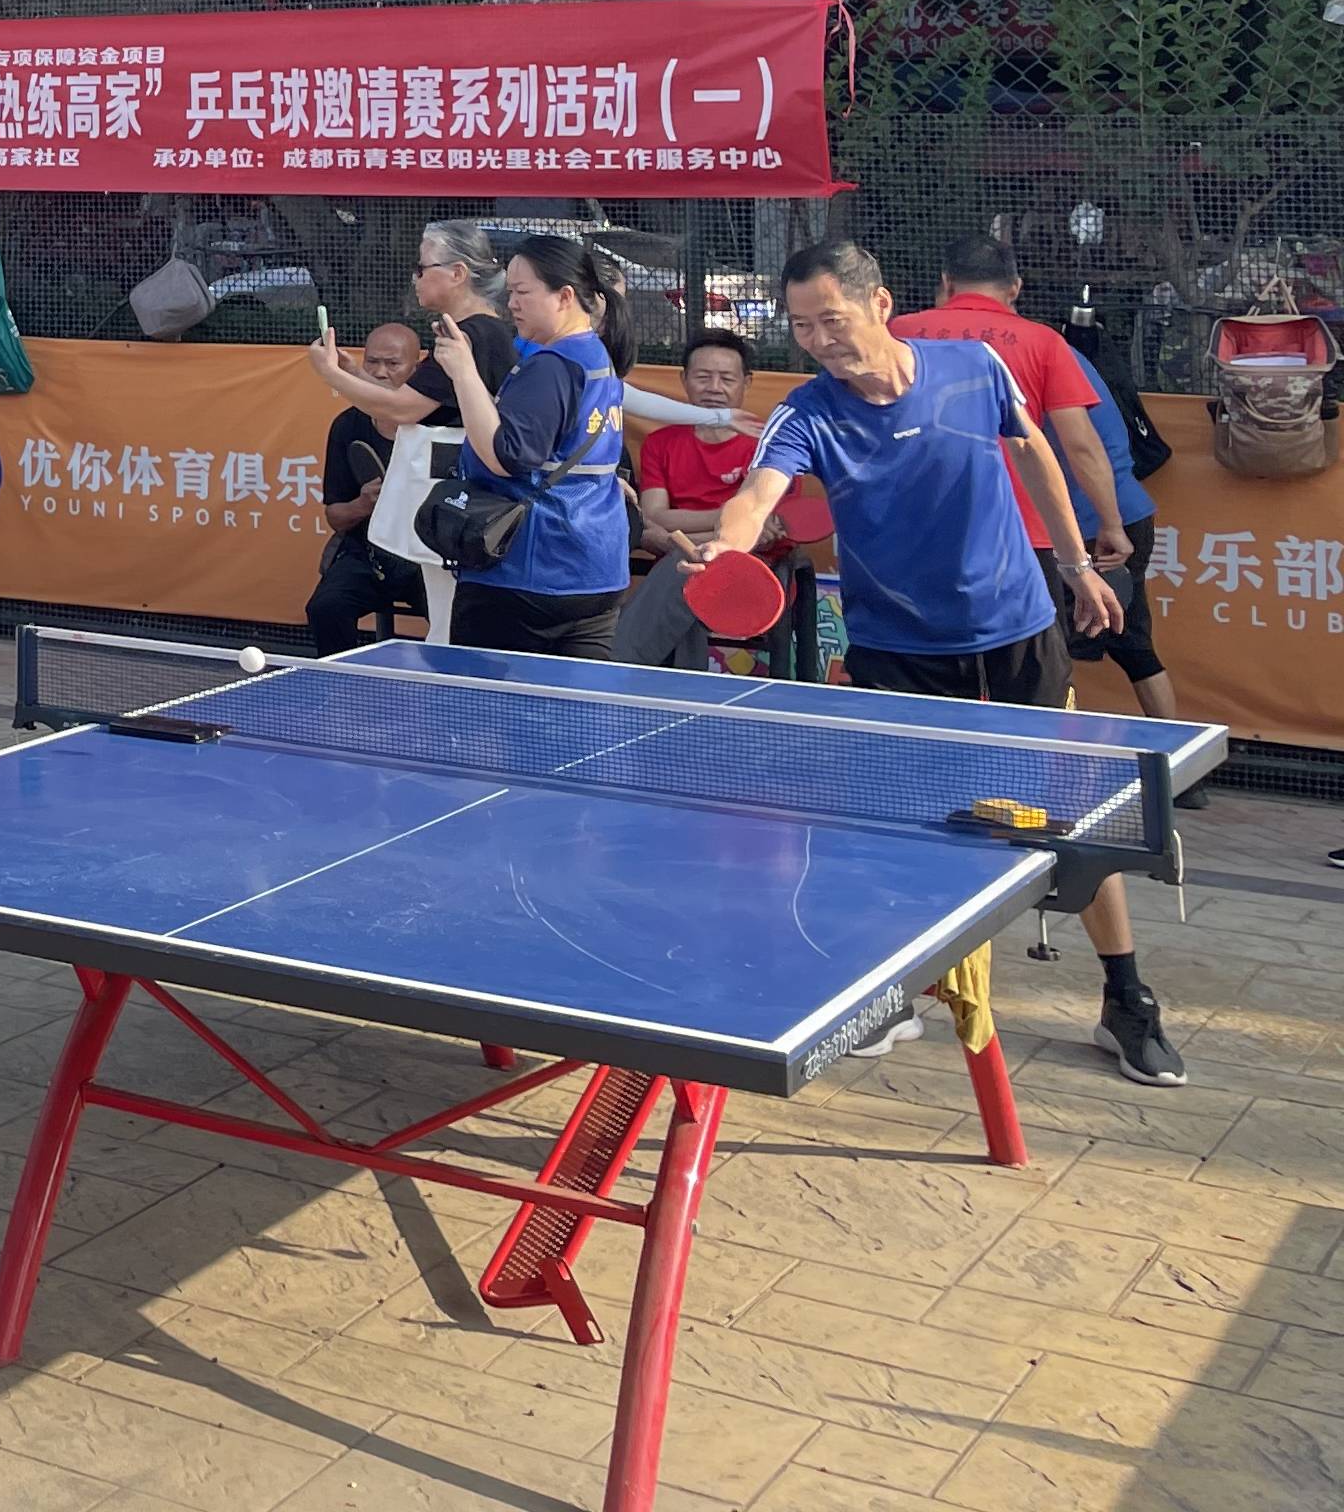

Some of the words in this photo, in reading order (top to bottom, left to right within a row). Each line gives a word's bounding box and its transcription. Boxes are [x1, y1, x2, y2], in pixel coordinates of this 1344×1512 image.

[186, 57, 774, 141] 乒乓球邀请赛系列活动（一）
[20, 494, 123, 519] YOUNI
[149, 504, 262, 529] SPORT
[1213, 602, 1344, 633] CLUB
